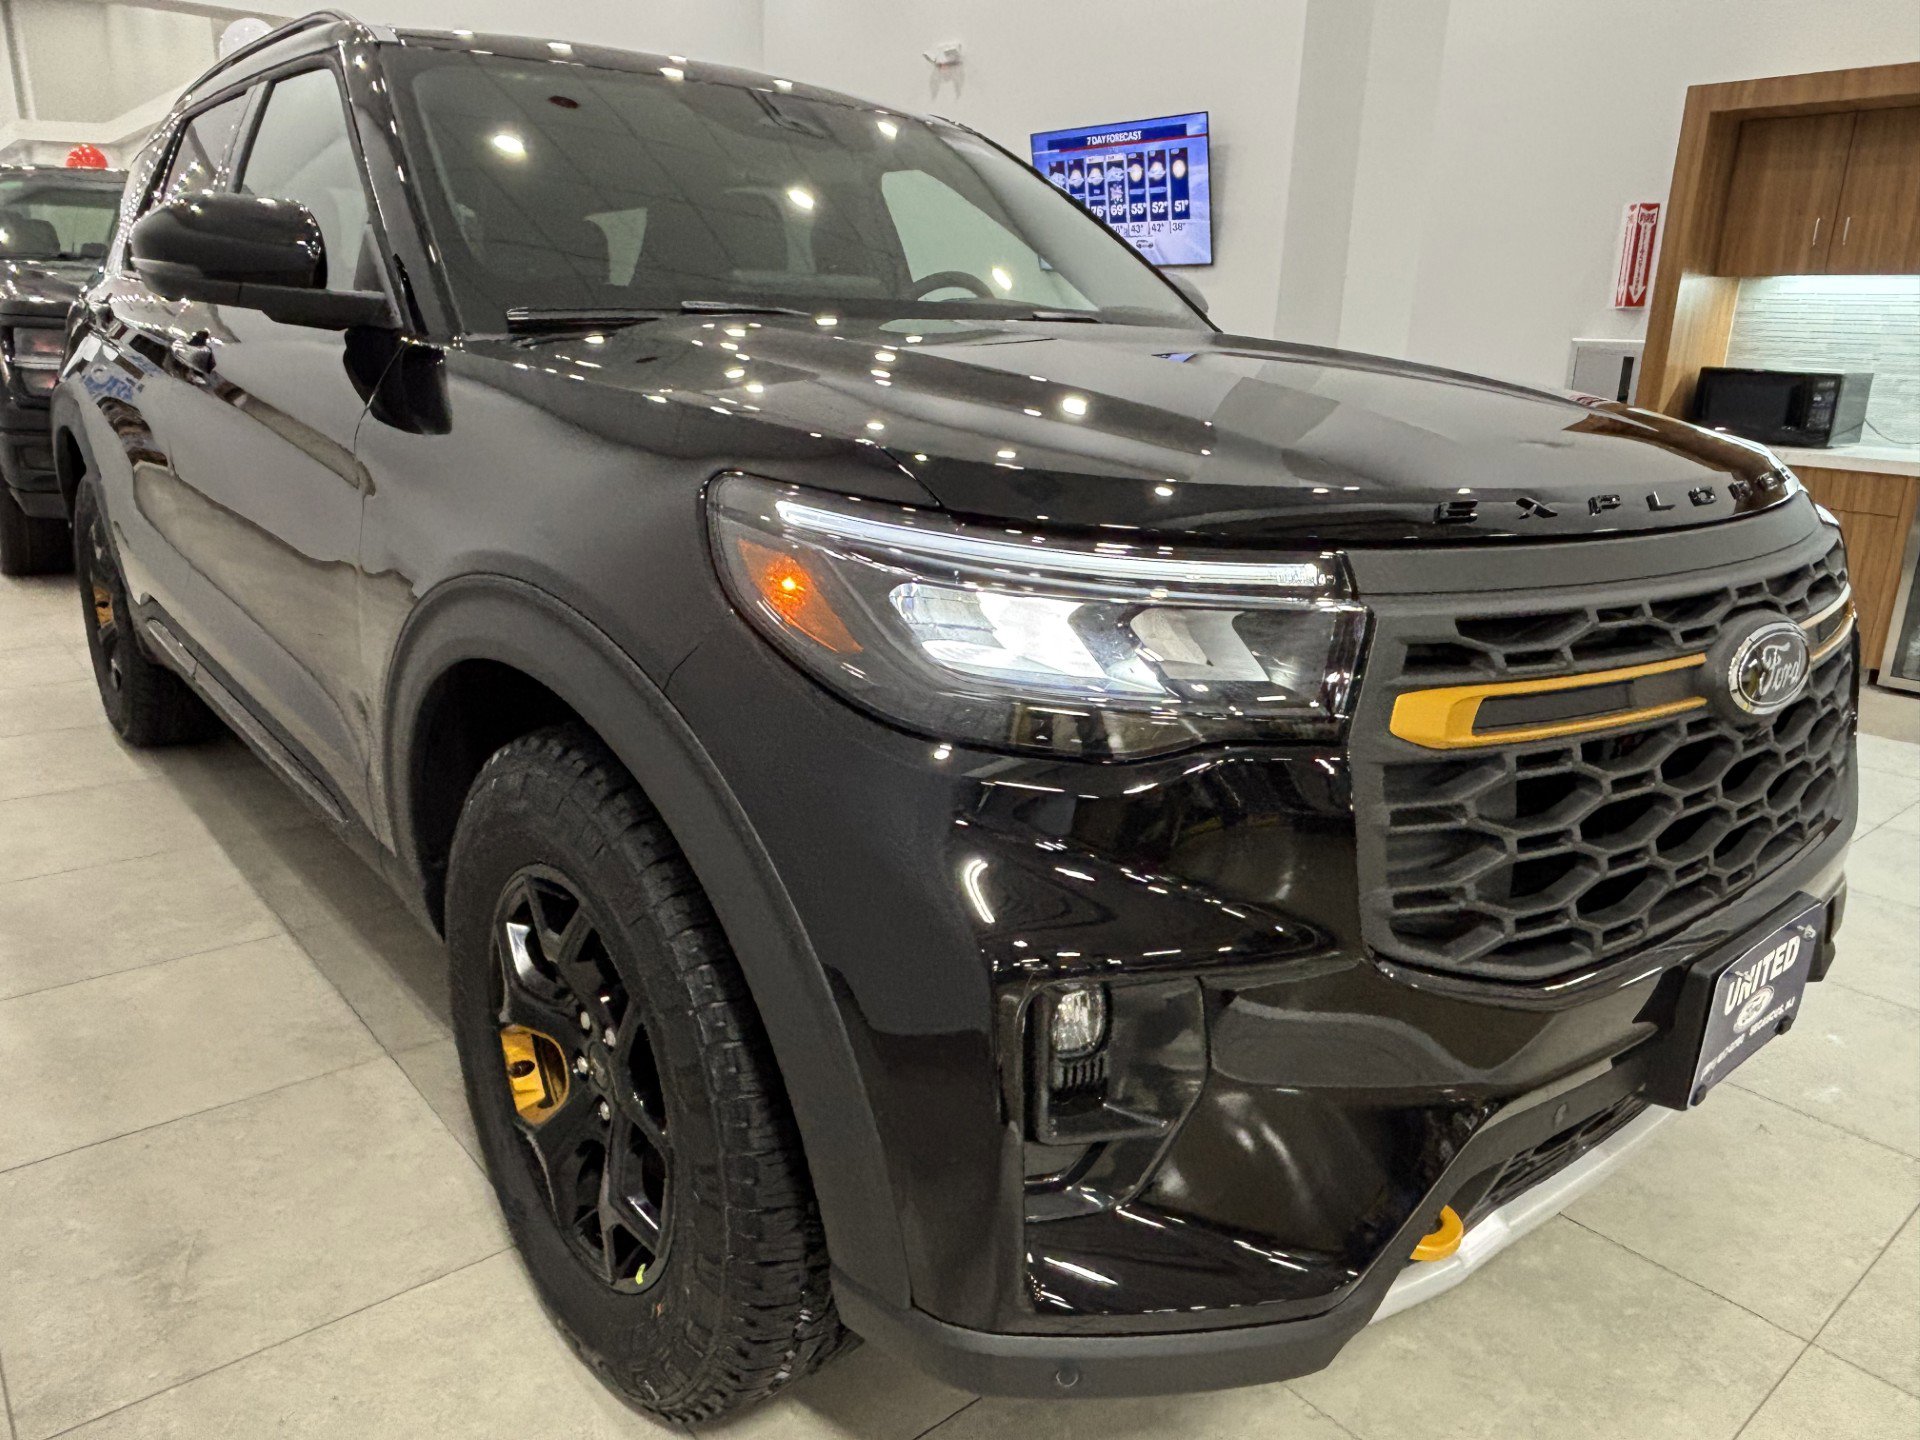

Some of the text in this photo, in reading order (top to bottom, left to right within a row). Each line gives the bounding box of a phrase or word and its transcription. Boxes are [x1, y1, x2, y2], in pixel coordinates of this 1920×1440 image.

[1092, 134, 1106, 145] DAY
[1106, 130, 1142, 143] FORECAST
[1174, 199, 1189, 212] 51°
[1751, 641, 1800, 700] Ford
[1725, 935, 1800, 1016] UNITED
